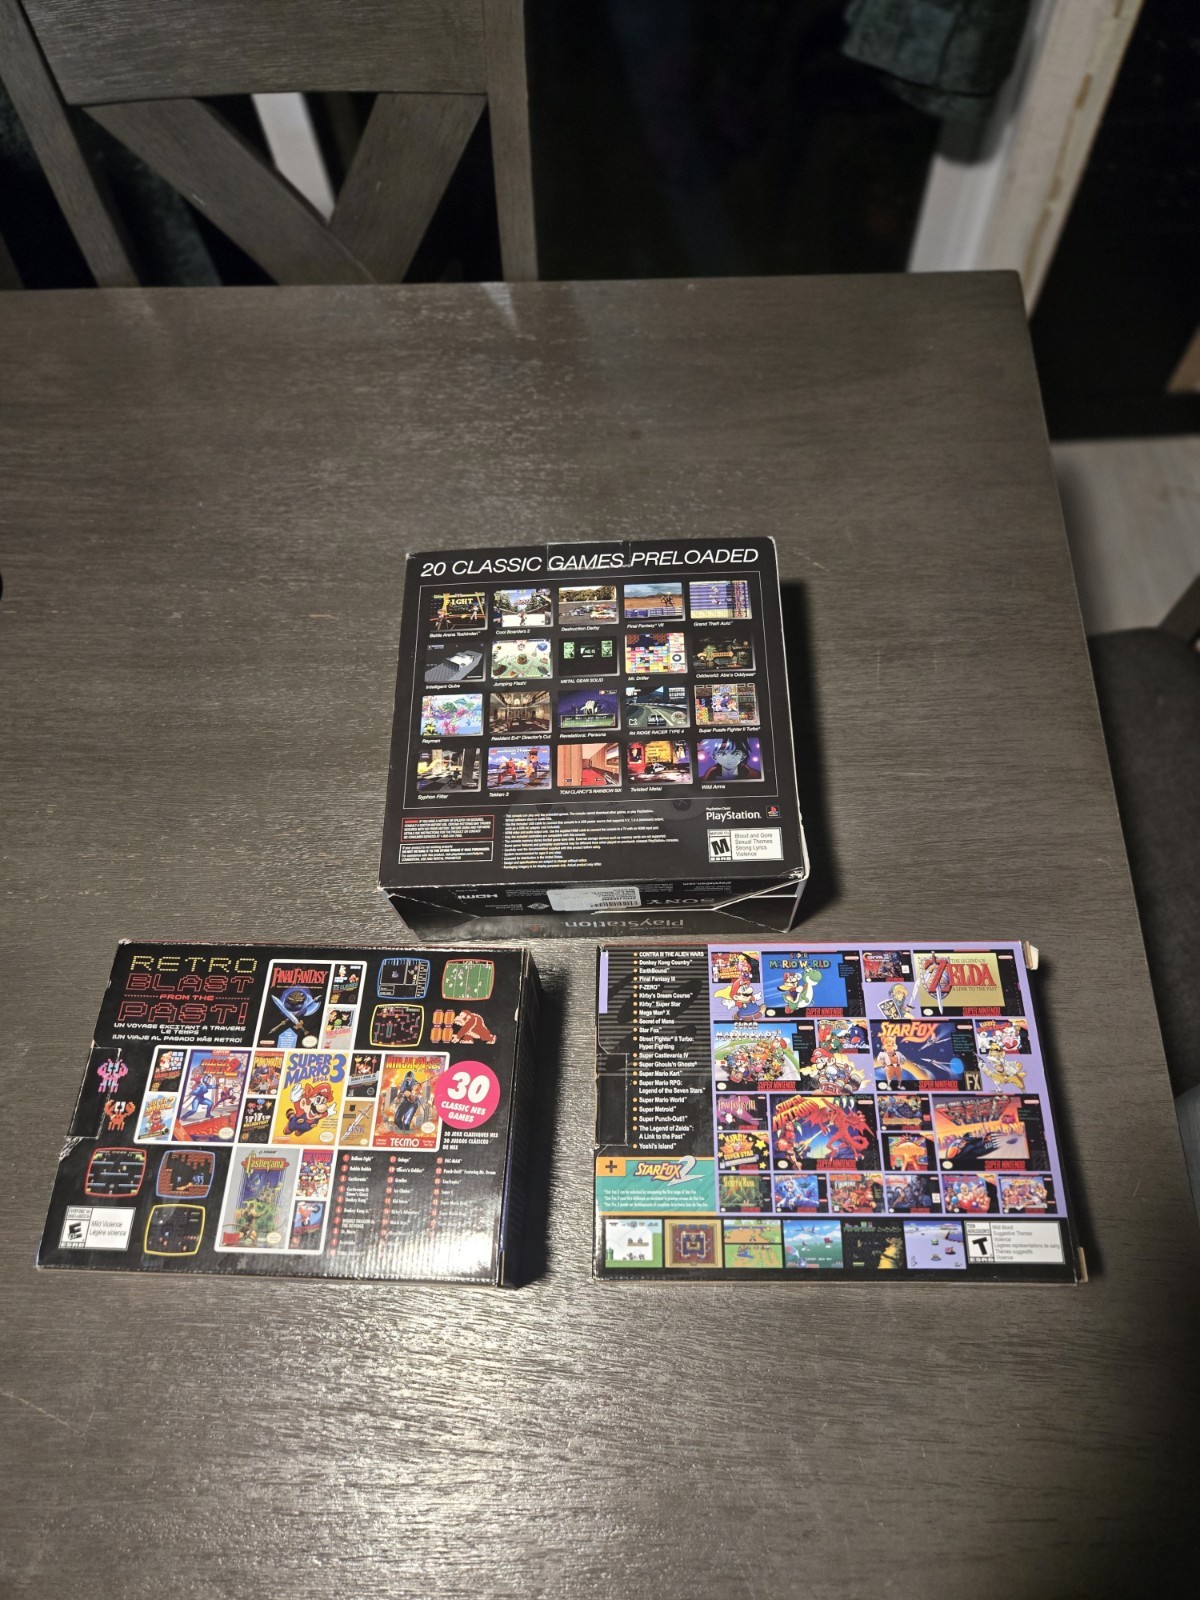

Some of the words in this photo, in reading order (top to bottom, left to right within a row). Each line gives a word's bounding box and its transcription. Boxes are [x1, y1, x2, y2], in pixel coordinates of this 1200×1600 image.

[420, 562, 447, 578] 20
[451, 556, 543, 575] CLASSIC
[547, 553, 625, 572] GAMES
[630, 548, 759, 568] PRELOADED
[710, 838, 730, 856] M
[130, 955, 258, 973] RETRO
[125, 972, 255, 994] BLAST
[923, 959, 998, 994] ZELDA
[117, 1001, 249, 1025] PAST!
[289, 1052, 334, 1071] SUPER
[329, 1053, 347, 1084] 3
[385, 1056, 414, 1069] NINJA
[283, 1064, 332, 1089] MARIO
[965, 1074, 982, 1089] FX
[447, 1071, 491, 1104] 30
[441, 1101, 471, 1112] CLASSIC
[470, 1108, 486, 1116] NES
[775, 1094, 803, 1112] SUPER
[448, 1112, 475, 1123] GAMES
[390, 1137, 420, 1147] TECMO
[667, 1155, 706, 1187] 2
[971, 1236, 988, 1256] T
